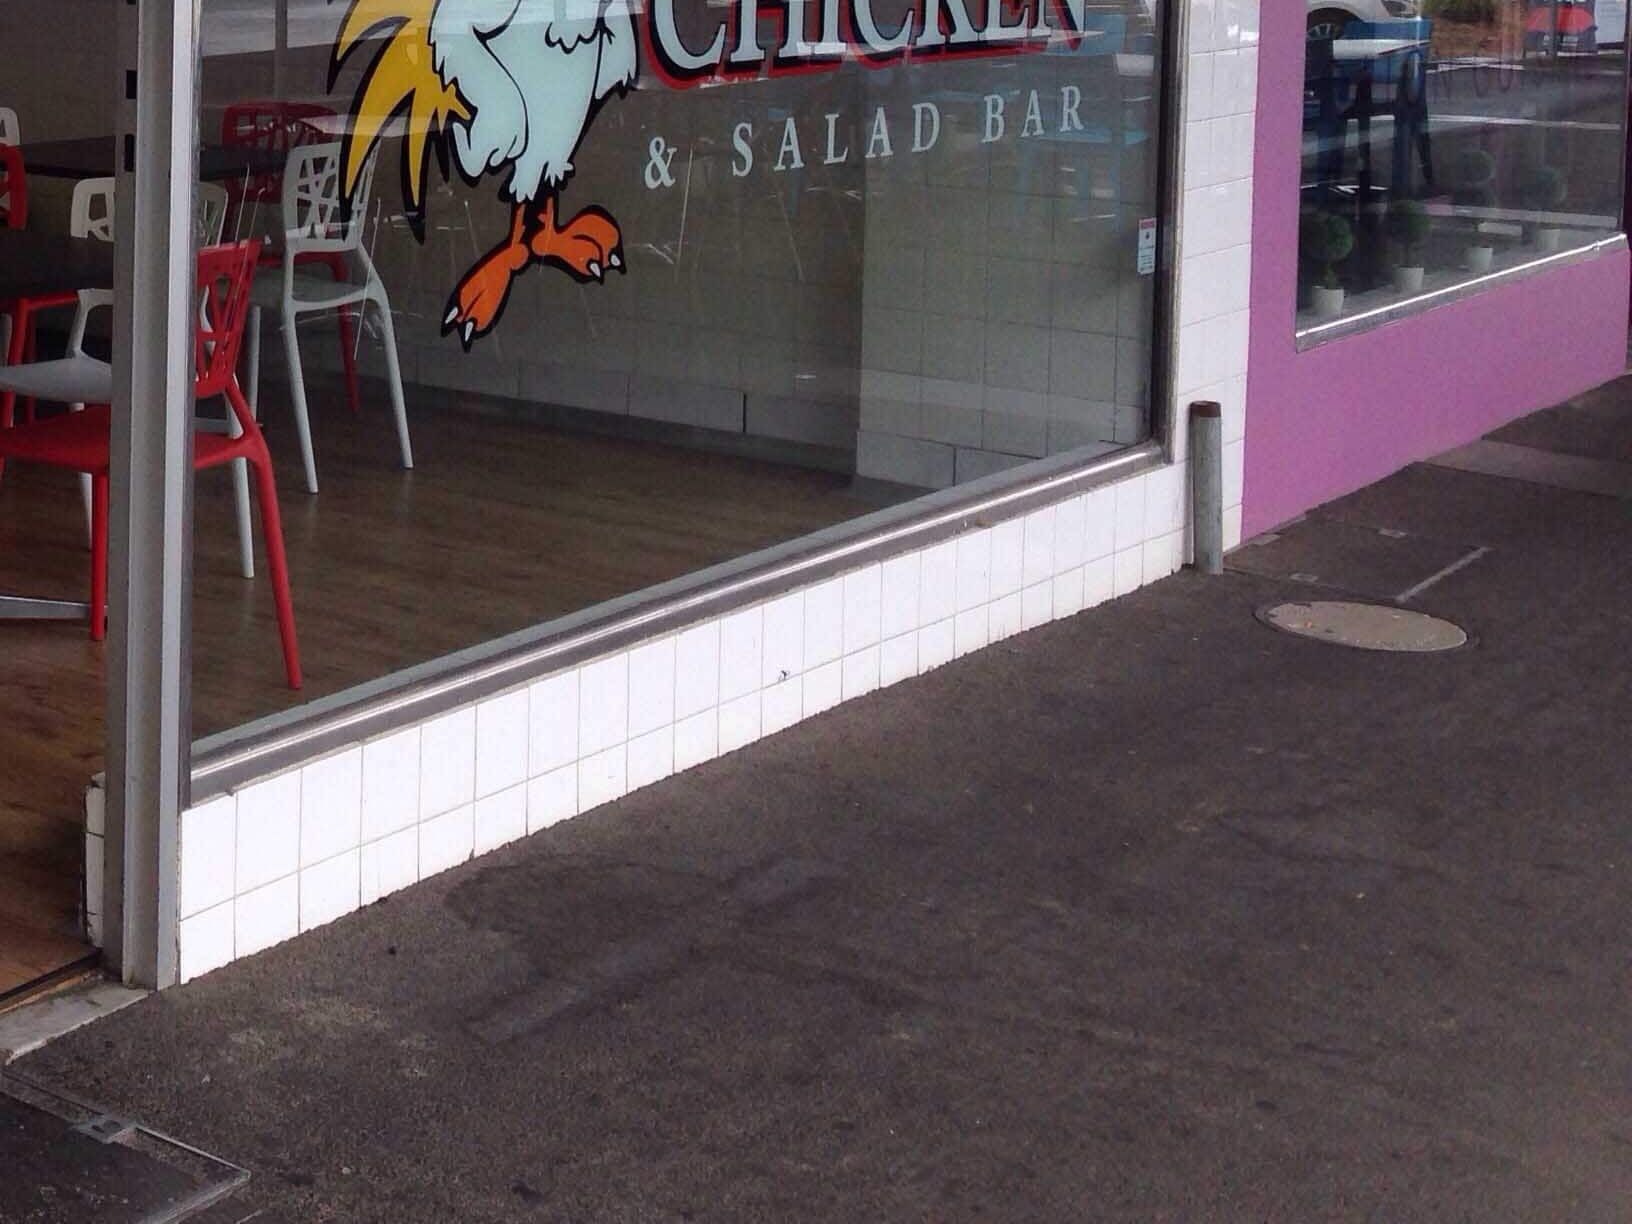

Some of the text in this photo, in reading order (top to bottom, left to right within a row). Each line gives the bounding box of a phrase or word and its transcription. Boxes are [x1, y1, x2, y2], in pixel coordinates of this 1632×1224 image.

[643, 84, 1086, 189] & SALAD BAR
